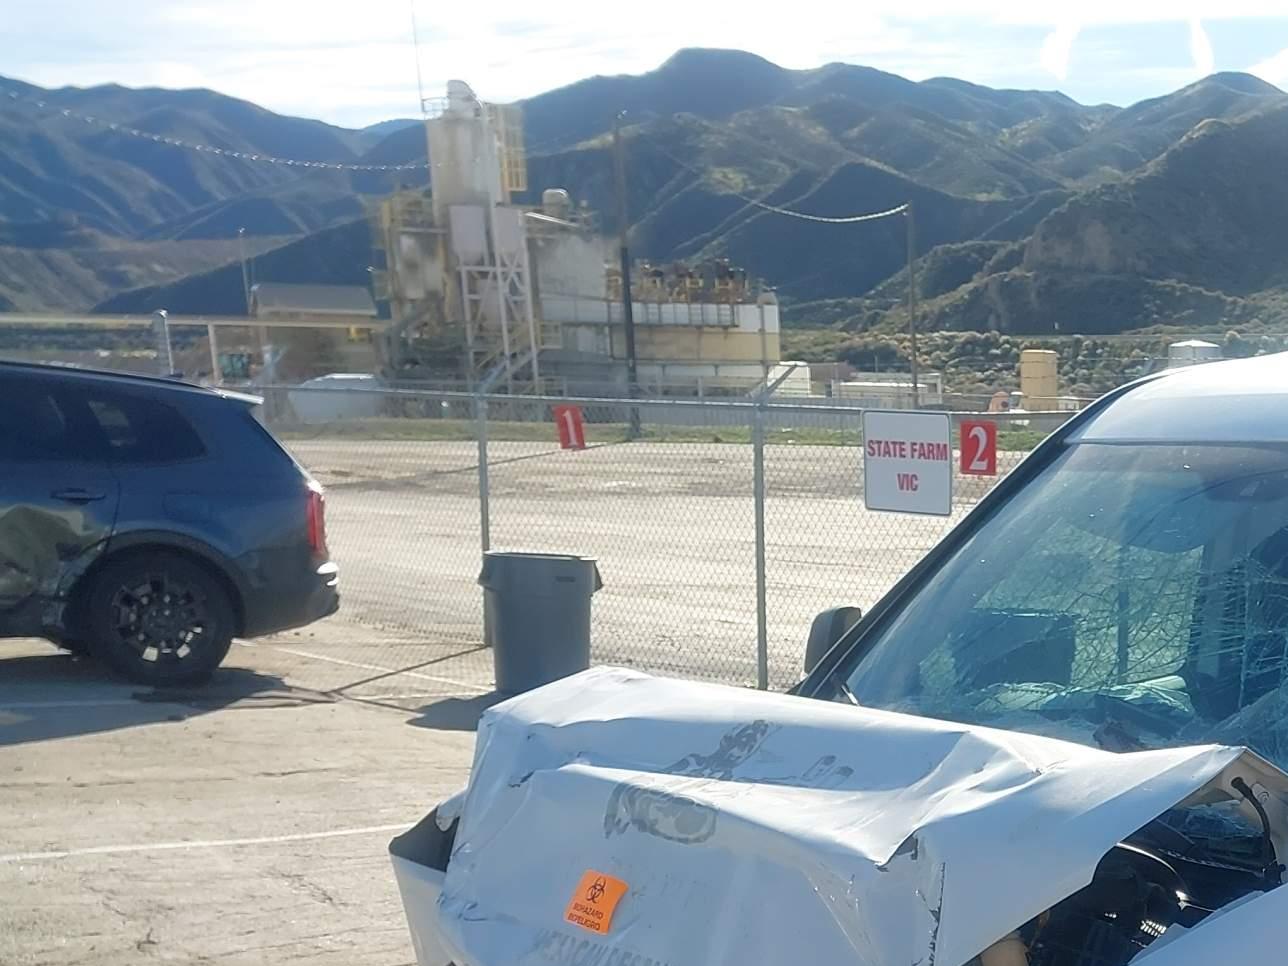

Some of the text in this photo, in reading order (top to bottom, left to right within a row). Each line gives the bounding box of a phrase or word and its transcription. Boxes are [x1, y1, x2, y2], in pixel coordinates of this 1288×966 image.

[563, 409, 578, 446] 1
[867, 439, 948, 461] STATE FARM
[968, 426, 989, 471] 2
[897, 473, 919, 492] VIC
